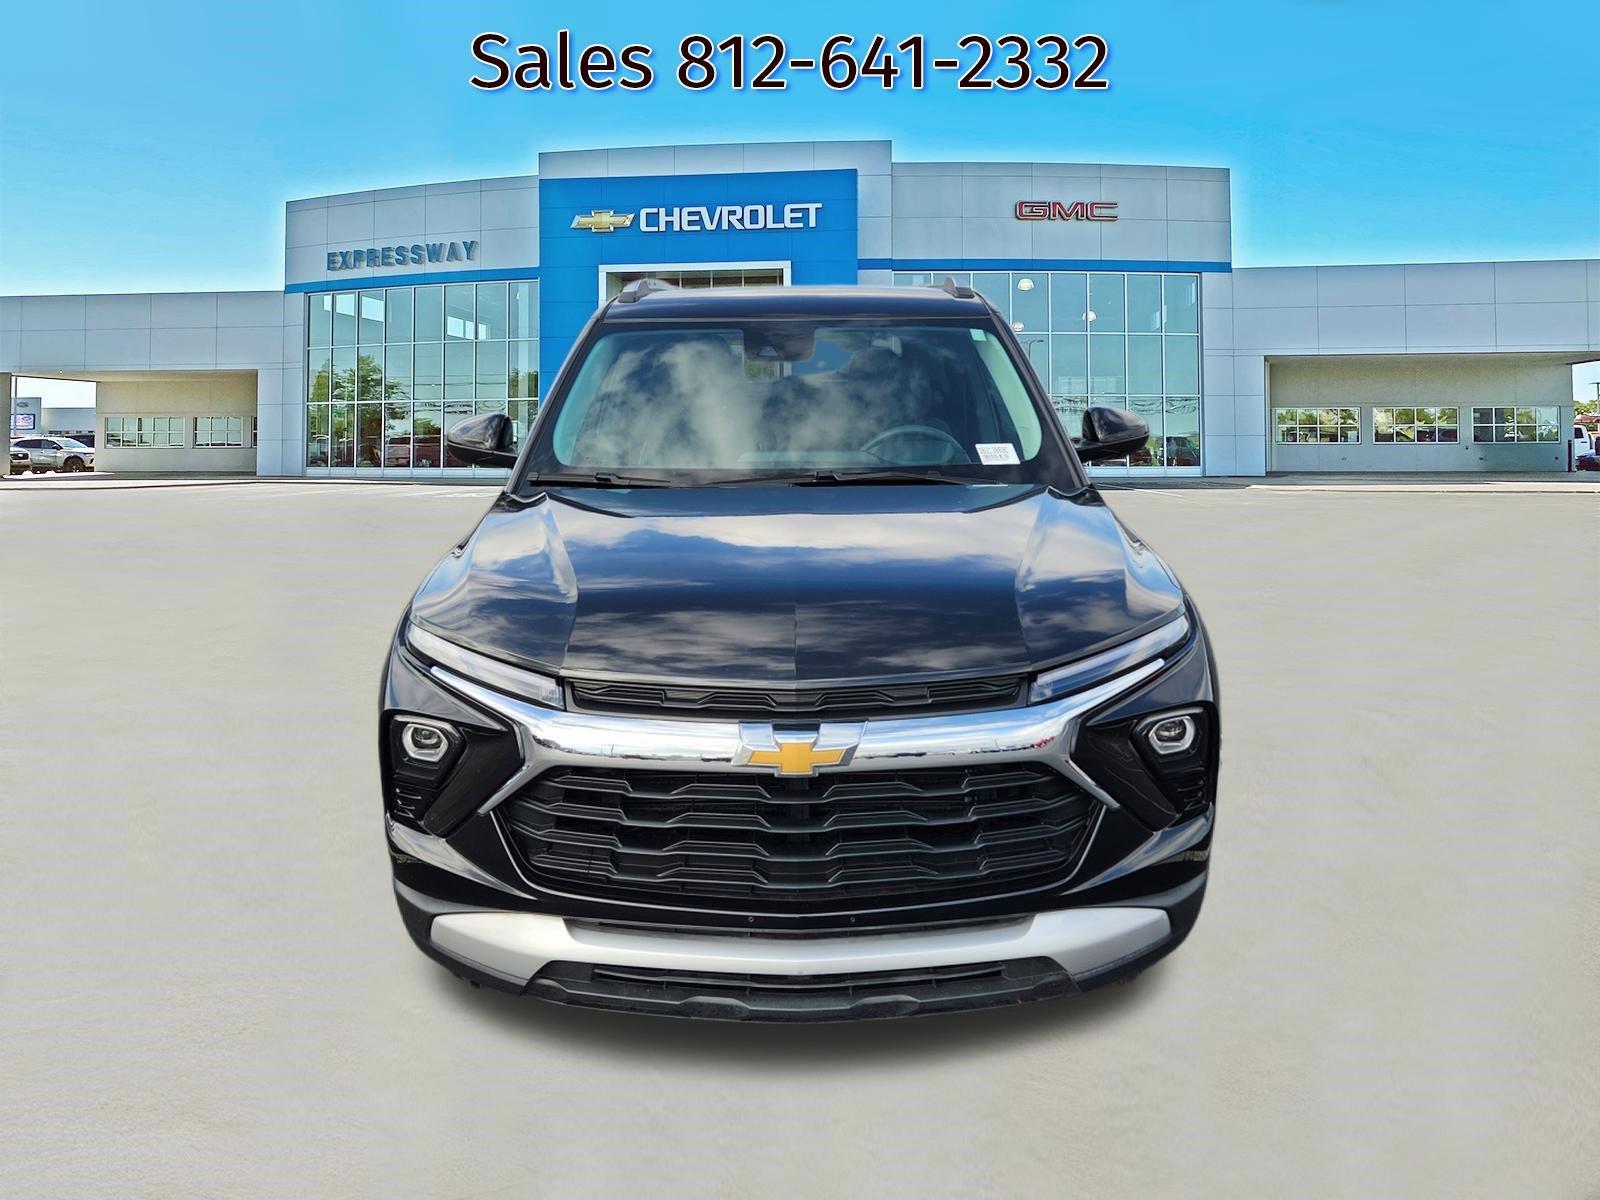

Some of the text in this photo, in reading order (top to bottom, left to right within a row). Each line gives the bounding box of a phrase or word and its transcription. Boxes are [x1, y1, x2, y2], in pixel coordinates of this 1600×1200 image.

[639, 203, 822, 231] CHEVROLET
[1015, 200, 1119, 221] GMC
[326, 240, 478, 271] EXPRESSWAY
